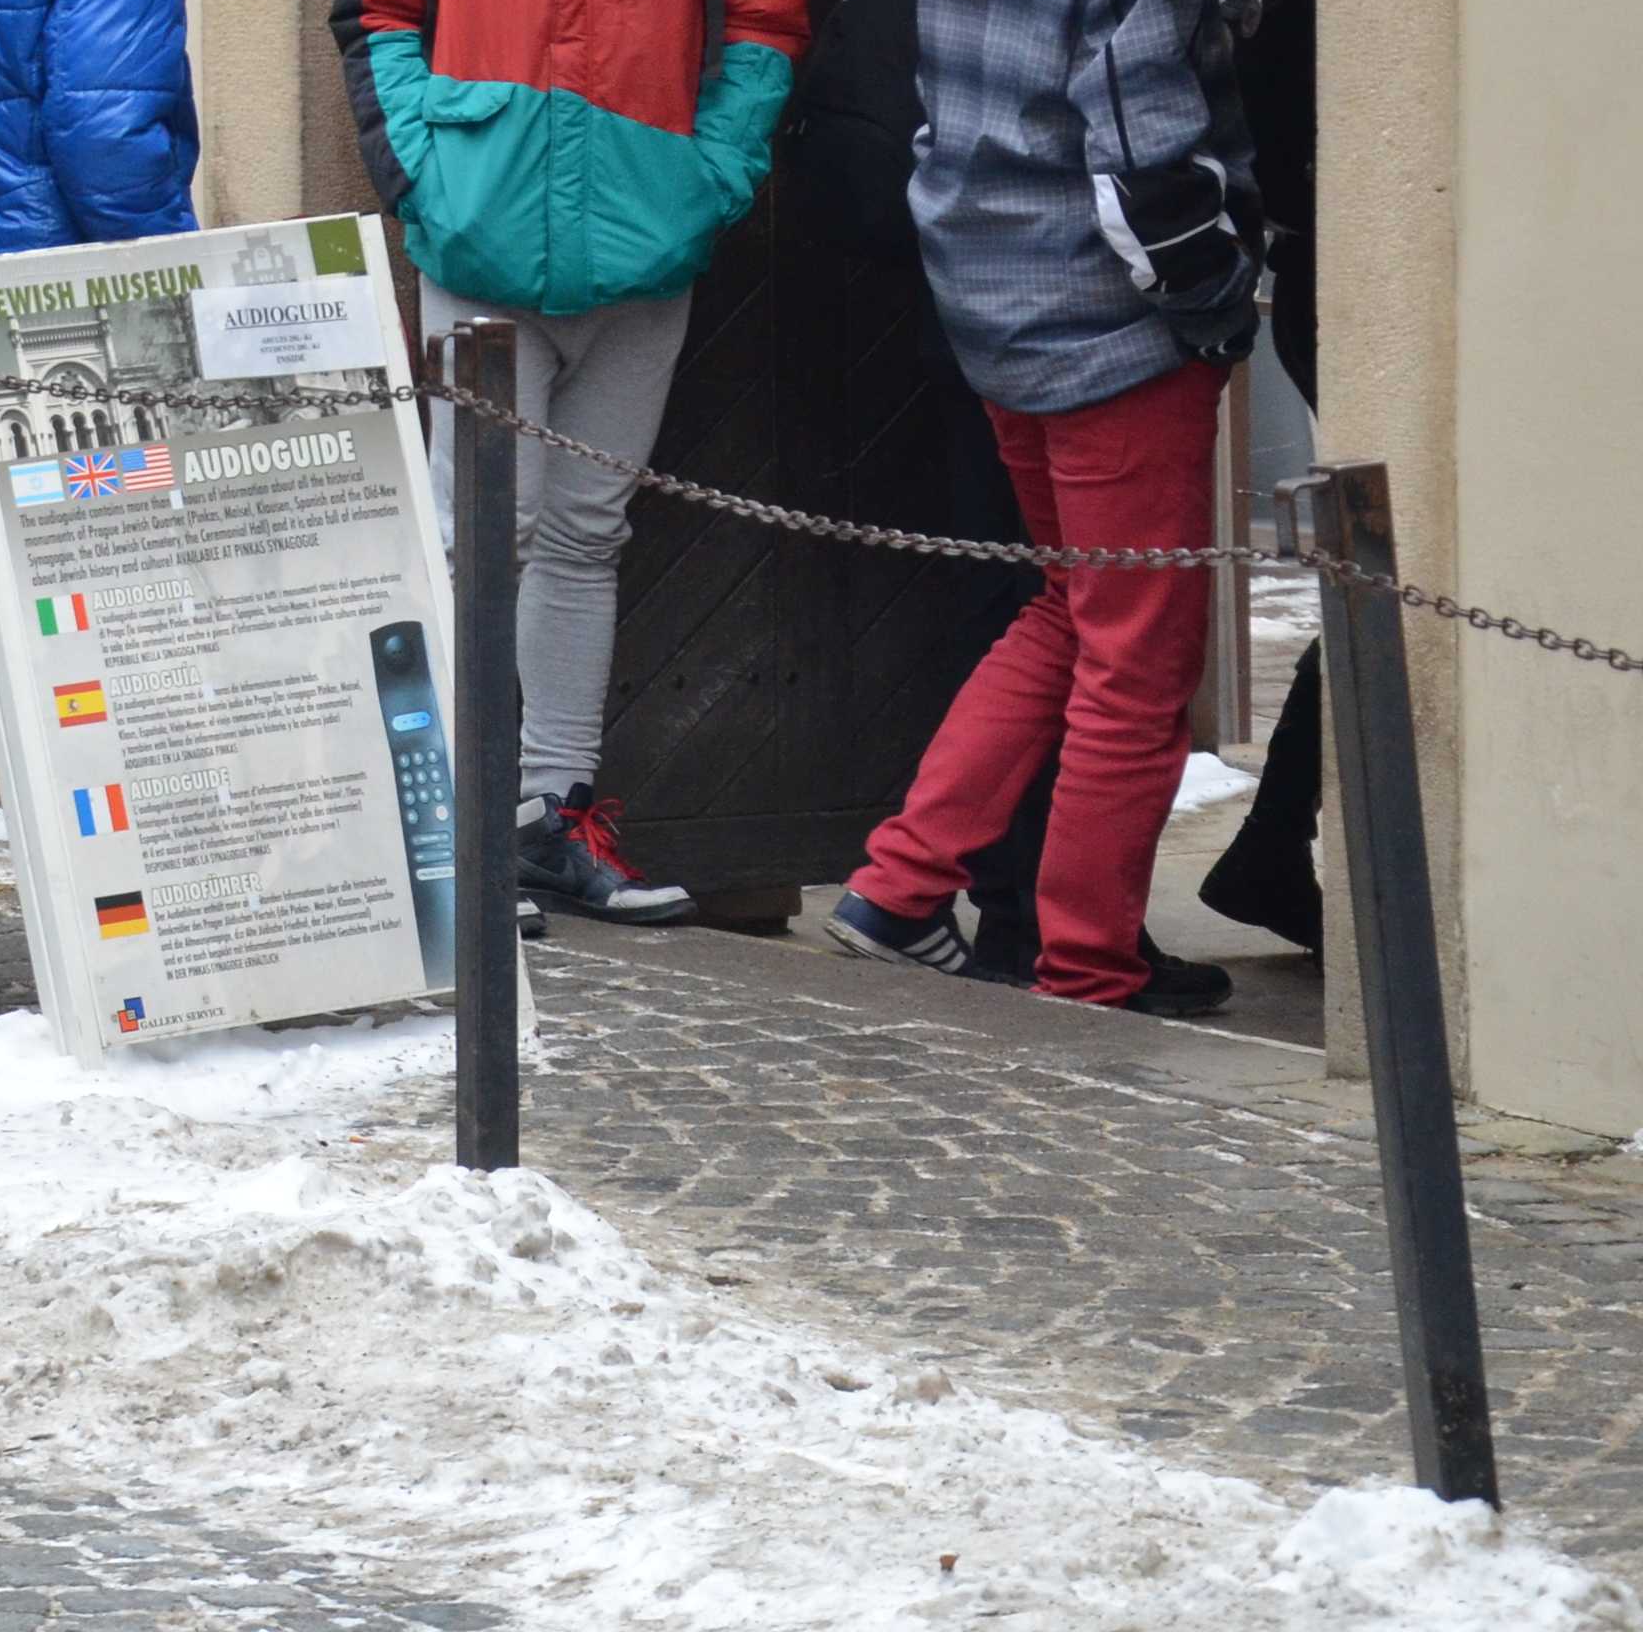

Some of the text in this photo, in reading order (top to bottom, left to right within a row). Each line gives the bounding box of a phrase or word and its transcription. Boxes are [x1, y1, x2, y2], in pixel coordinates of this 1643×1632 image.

[86, 264, 205, 307] MUSEUM
[225, 301, 348, 328] AUDIOGUIDE
[178, 429, 358, 485] AUDIOGUIDE
[23, 528, 75, 546] monuments
[87, 522, 119, 540] Prague
[120, 517, 150, 533] Jewish
[150, 512, 185, 530] Quarter
[293, 491, 328, 512] Spanish
[328, 489, 346, 504] and
[362, 481, 397, 499] Old-New
[36, 506, 87, 529] audioguide
[87, 500, 124, 518] contains
[126, 500, 149, 513] more
[150, 494, 171, 510] than
[217, 480, 269, 500] information
[270, 477, 296, 493] about
[325, 467, 364, 485] historical
[110, 539, 140, 554] Jewish
[199, 523, 248, 542] Ceremonial
[305, 512, 324, 527] also
[350, 501, 398, 520] information
[30, 569, 57, 586] about
[57, 565, 87, 582] Jewish
[88, 560, 120, 580] history
[120, 558, 139, 573] and
[174, 546, 220, 565] AVAILABLE
[233, 540, 265, 557] PINKAS
[266, 532, 319, 552] SYNAGOGUE
[90, 577, 194, 610] AUDIOGUIDA
[106, 659, 202, 697] AUDIOGUÍA
[127, 766, 232, 801] AUDIOGUIDE
[148, 865, 265, 908] AUDIOFÜHRER
[139, 1004, 226, 1030] GALLERY SERVICE
